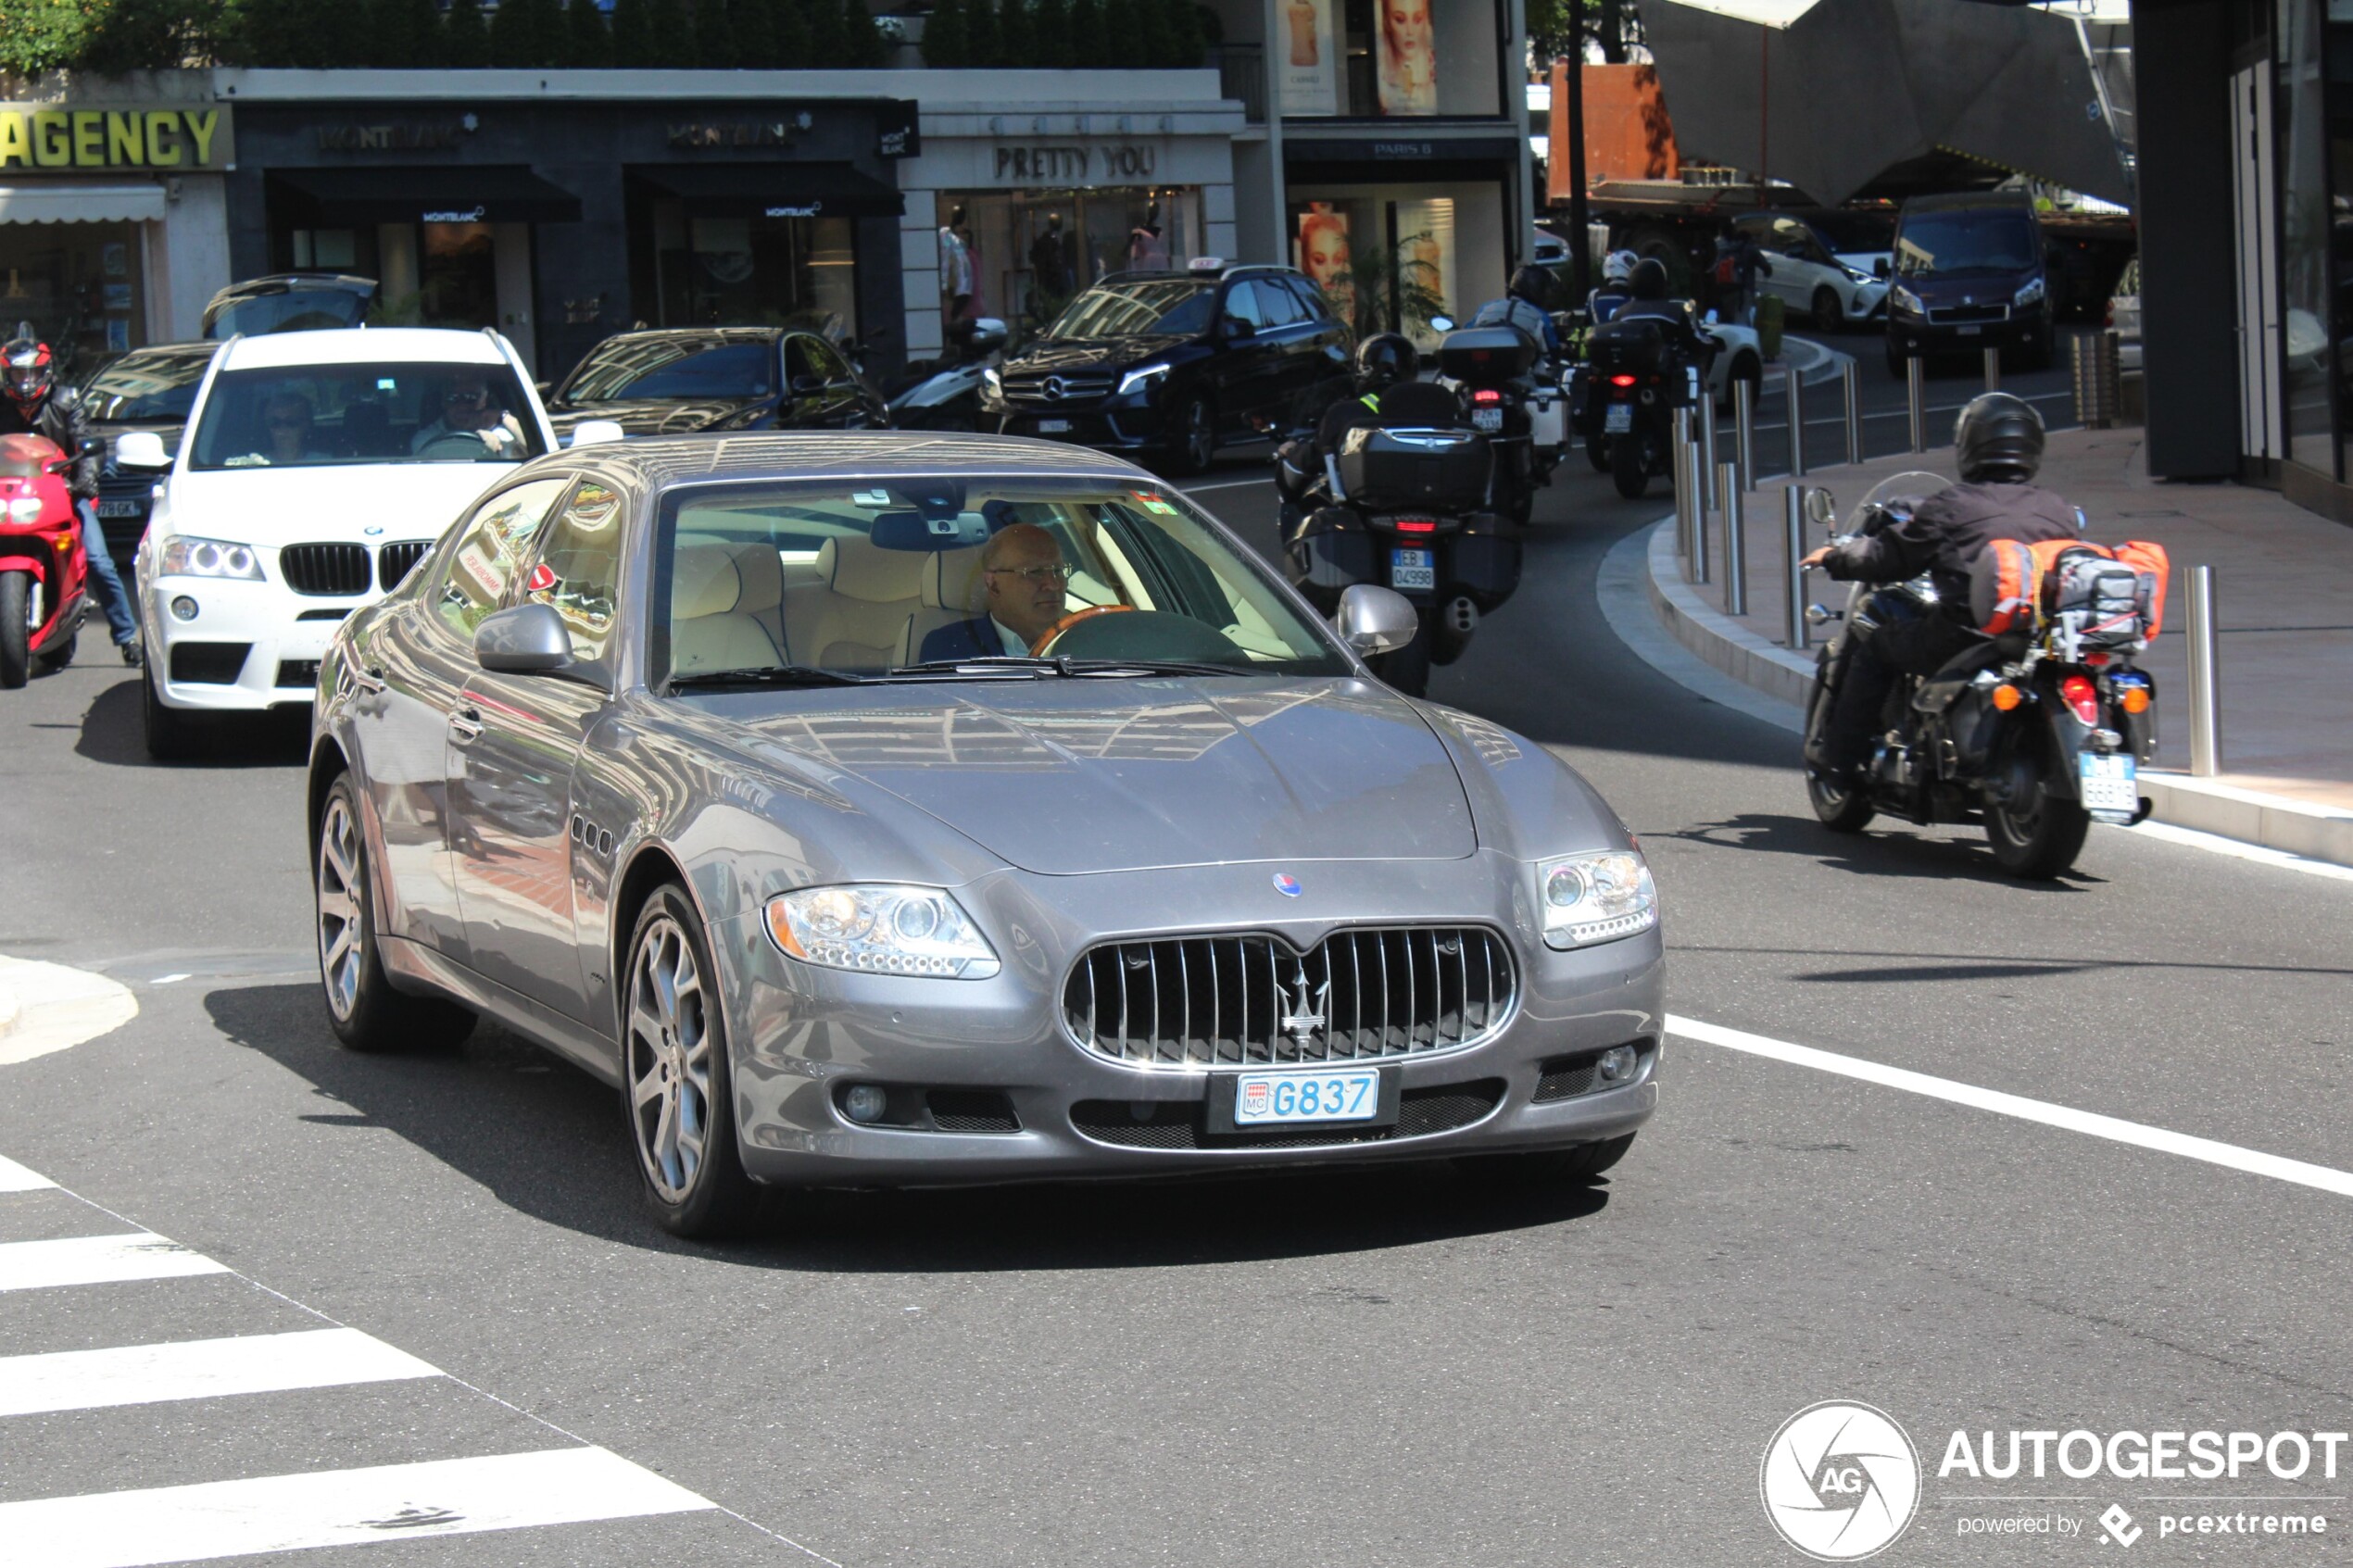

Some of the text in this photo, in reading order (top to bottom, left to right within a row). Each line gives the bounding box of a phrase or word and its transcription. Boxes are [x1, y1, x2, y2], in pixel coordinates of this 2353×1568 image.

[0, 110, 219, 168] AGENCY
[1374, 144, 1418, 155] PARIS
[992, 145, 1155, 179] PRETTY YOU
[422, 212, 479, 222] MONTBLANC
[1403, 551, 1417, 566] EB
[1395, 570, 1431, 585] 04998
[1247, 1077, 1371, 1116] MC G837
